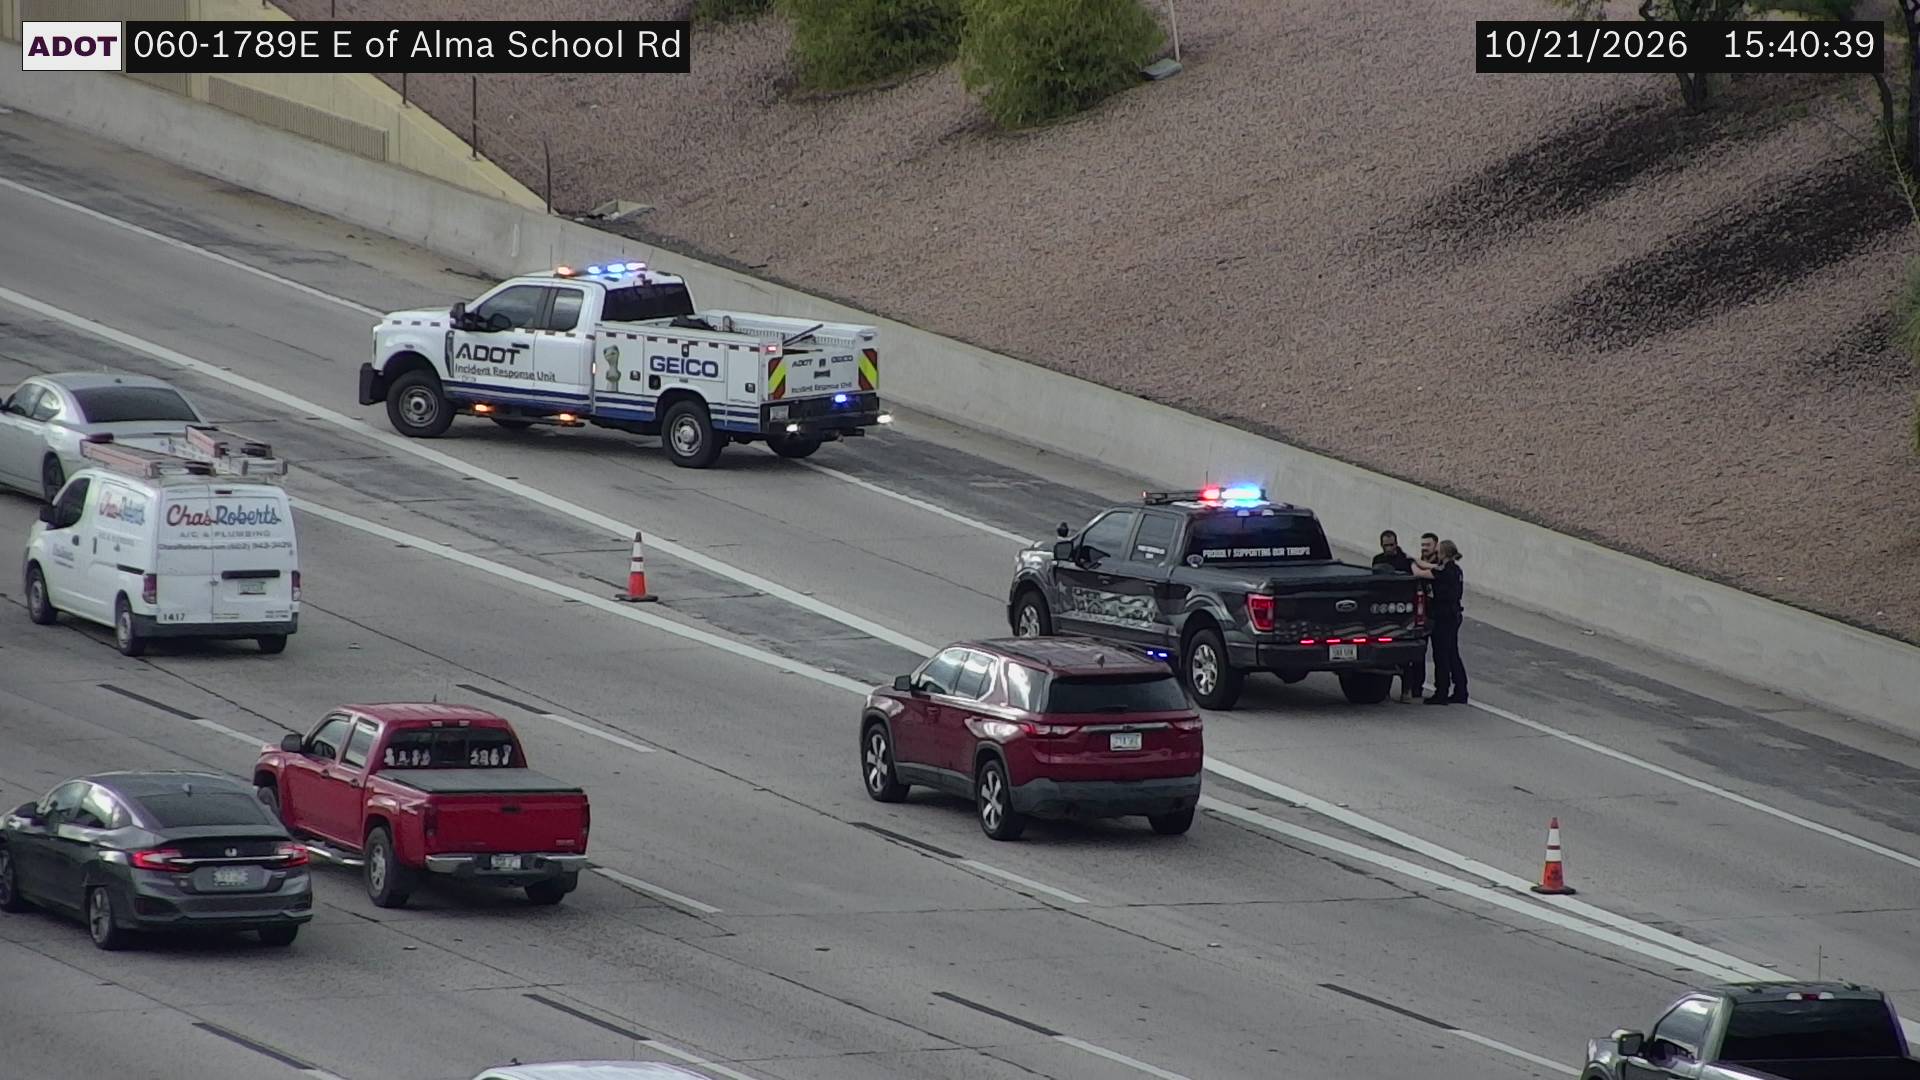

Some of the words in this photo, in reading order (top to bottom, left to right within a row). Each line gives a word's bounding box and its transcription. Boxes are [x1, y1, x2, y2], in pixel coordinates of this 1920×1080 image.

[456, 342, 520, 365] ADOT
[791, 358, 813, 367] ADOT
[454, 363, 490, 376] Incident
[492, 366, 535, 381] Response
[537, 371, 556, 383] Unit
[649, 355, 719, 378] GEICO
